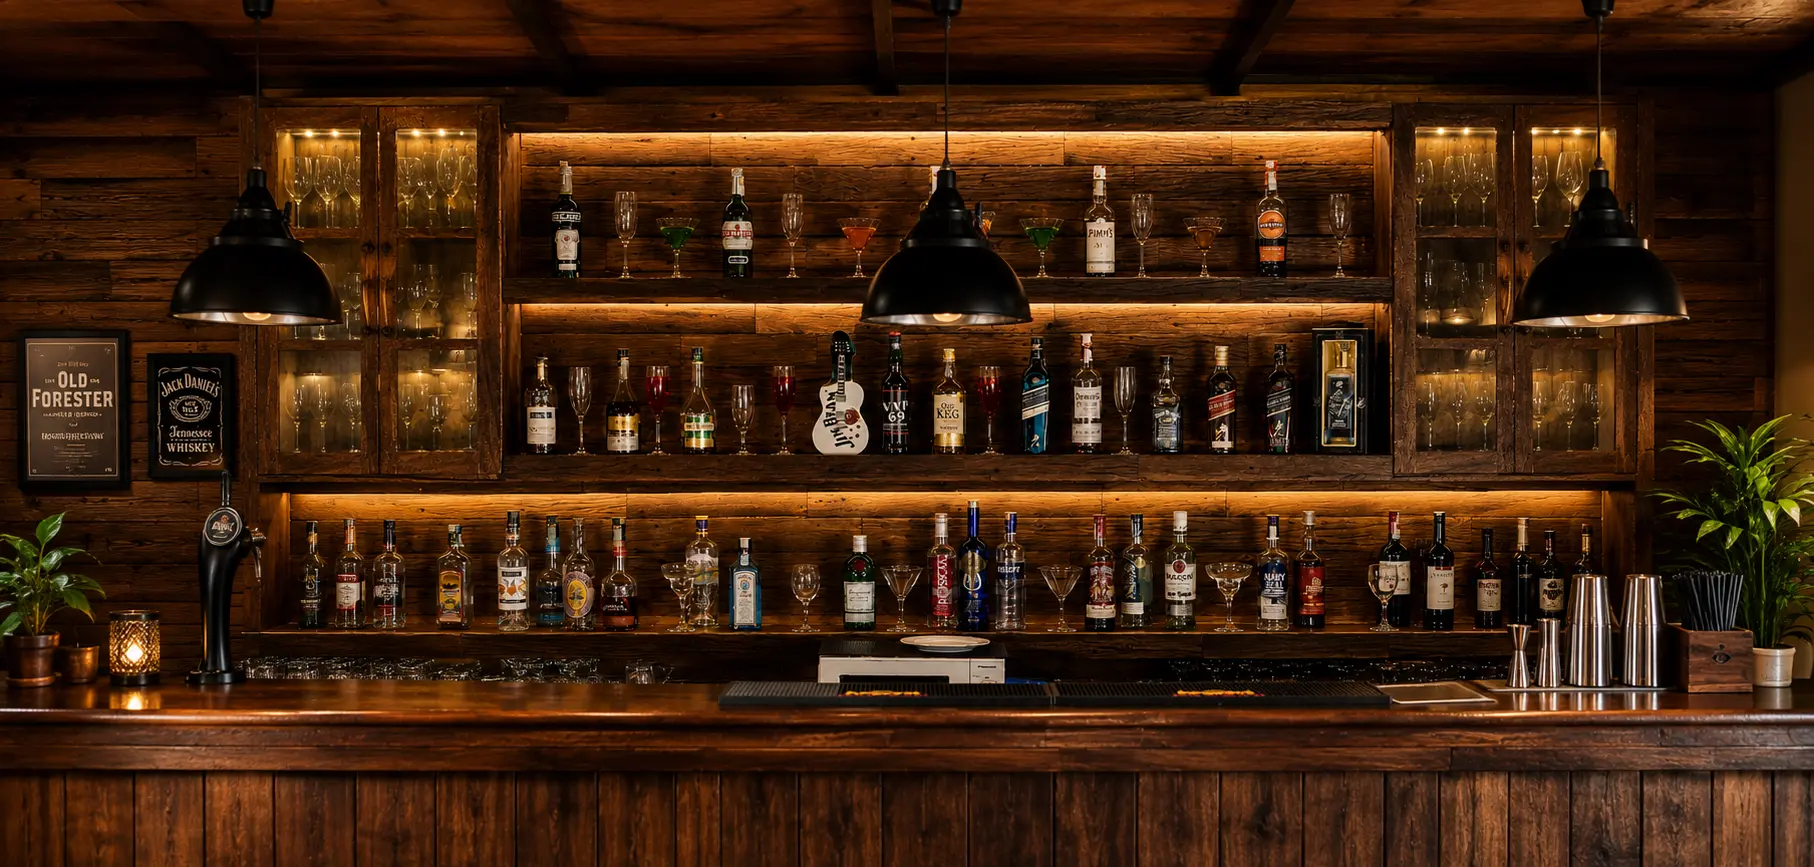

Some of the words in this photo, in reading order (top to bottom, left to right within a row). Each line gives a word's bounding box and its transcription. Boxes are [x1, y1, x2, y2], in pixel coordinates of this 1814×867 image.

[58, 370, 88, 388] OLD
[161, 378, 184, 398] JACK
[184, 373, 221, 398] DANIEL'S
[32, 388, 113, 408] FORESTER
[888, 411, 905, 422] 69
[166, 442, 215, 453] WHISKEY
